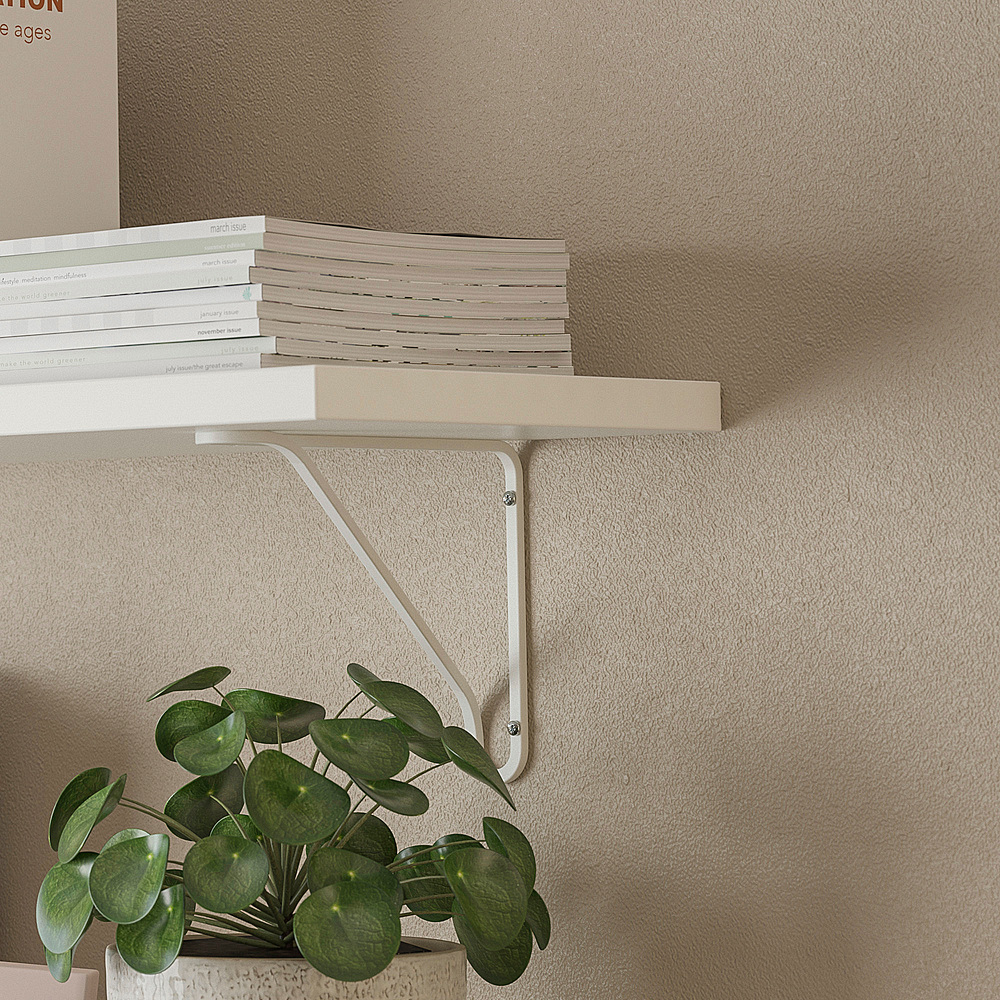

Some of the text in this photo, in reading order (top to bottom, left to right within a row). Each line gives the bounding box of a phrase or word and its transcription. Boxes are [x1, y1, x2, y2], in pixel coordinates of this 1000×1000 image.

[14, 24, 52, 44] ages
[210, 222, 230, 233] march
[230, 222, 247, 232] issue
[21, 275, 52, 283] meditation
[53, 272, 87, 281] mindfulness
[200, 310, 223, 318] january
[197, 328, 226, 336] november
[165, 364, 176, 373] july
[204, 362, 221, 371] great
[221, 361, 244, 370] escape
